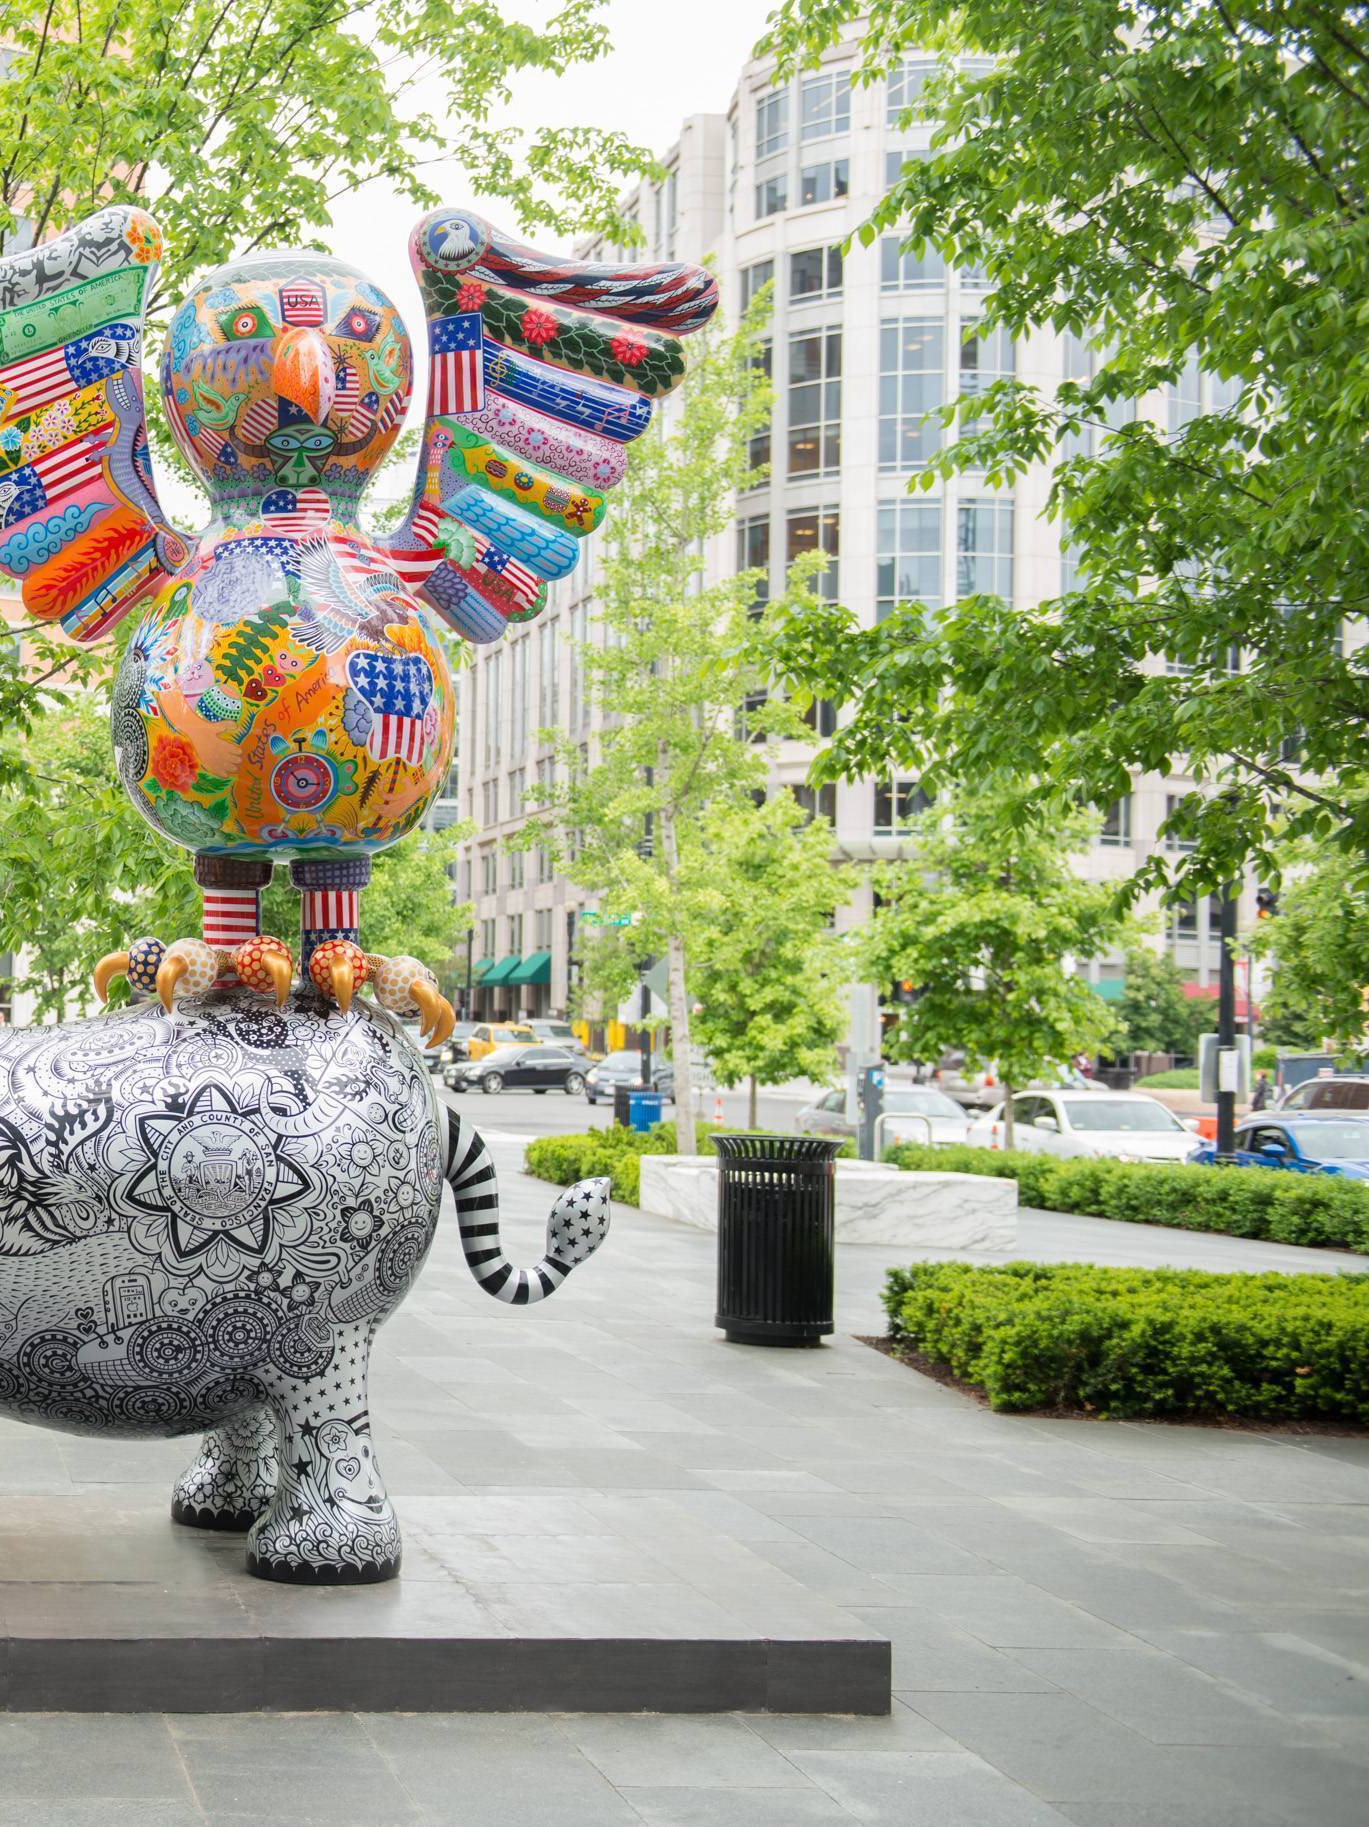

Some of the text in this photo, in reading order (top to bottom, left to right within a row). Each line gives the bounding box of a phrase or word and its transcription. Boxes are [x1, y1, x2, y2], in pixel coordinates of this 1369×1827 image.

[49, 293, 76, 307] STATES
[78, 285, 88, 296] OF
[90, 275, 122, 291] AMERICA
[287, 295, 321, 307] USA
[482, 569, 514, 604] USA
[245, 672, 329, 820] United States of Ameri
[176, 1119, 195, 1136] AND
[200, 1113, 246, 1127] COUNTY
[248, 1127, 262, 1139] OF
[160, 1139, 174, 1161] CITY
[260, 1143, 275, 1168] SAN
[158, 1169, 169, 1191] THE
[165, 1194, 177, 1207] OF
[220, 1180, 273, 1229] FRANCISCO
[177, 1206, 204, 1226] SEAL
